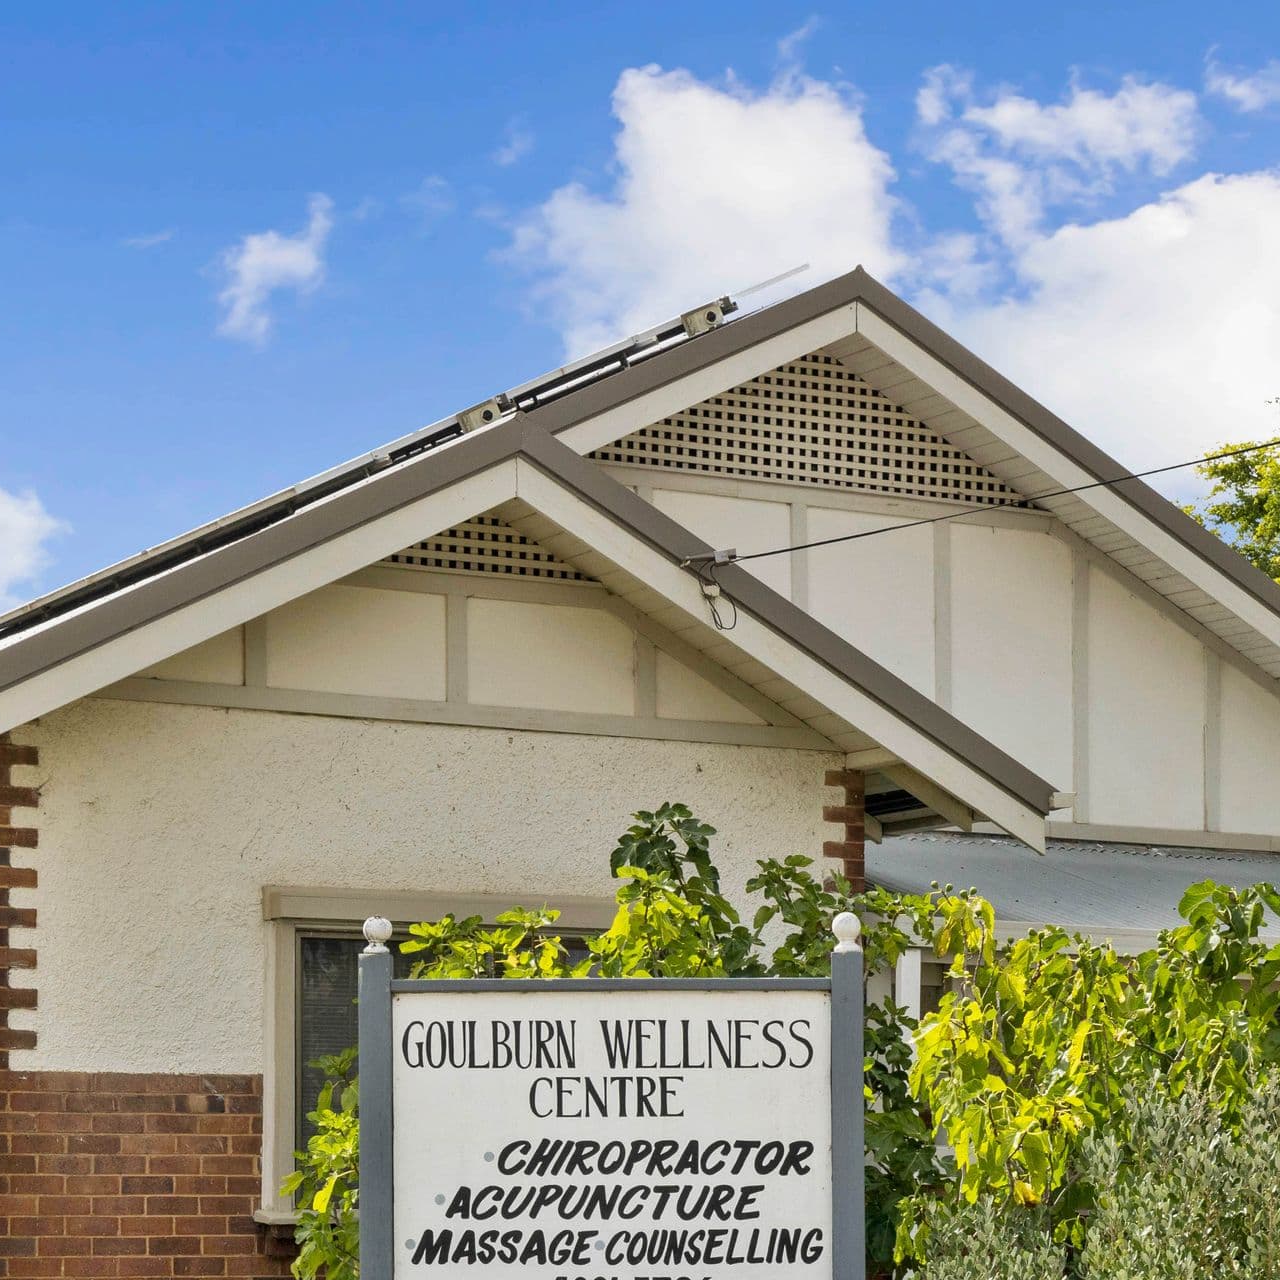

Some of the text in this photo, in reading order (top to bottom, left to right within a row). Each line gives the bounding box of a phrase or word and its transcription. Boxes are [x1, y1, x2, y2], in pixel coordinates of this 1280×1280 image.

[402, 1019, 814, 1069] GOULBURN WELLNESS
[529, 1076, 685, 1119] CENTRE
[497, 1138, 814, 1177] CHIROPRACTOR
[445, 1184, 765, 1221] ACUPUNCTURE
[412, 1228, 824, 1265] MASSAGE COUNSELLING
